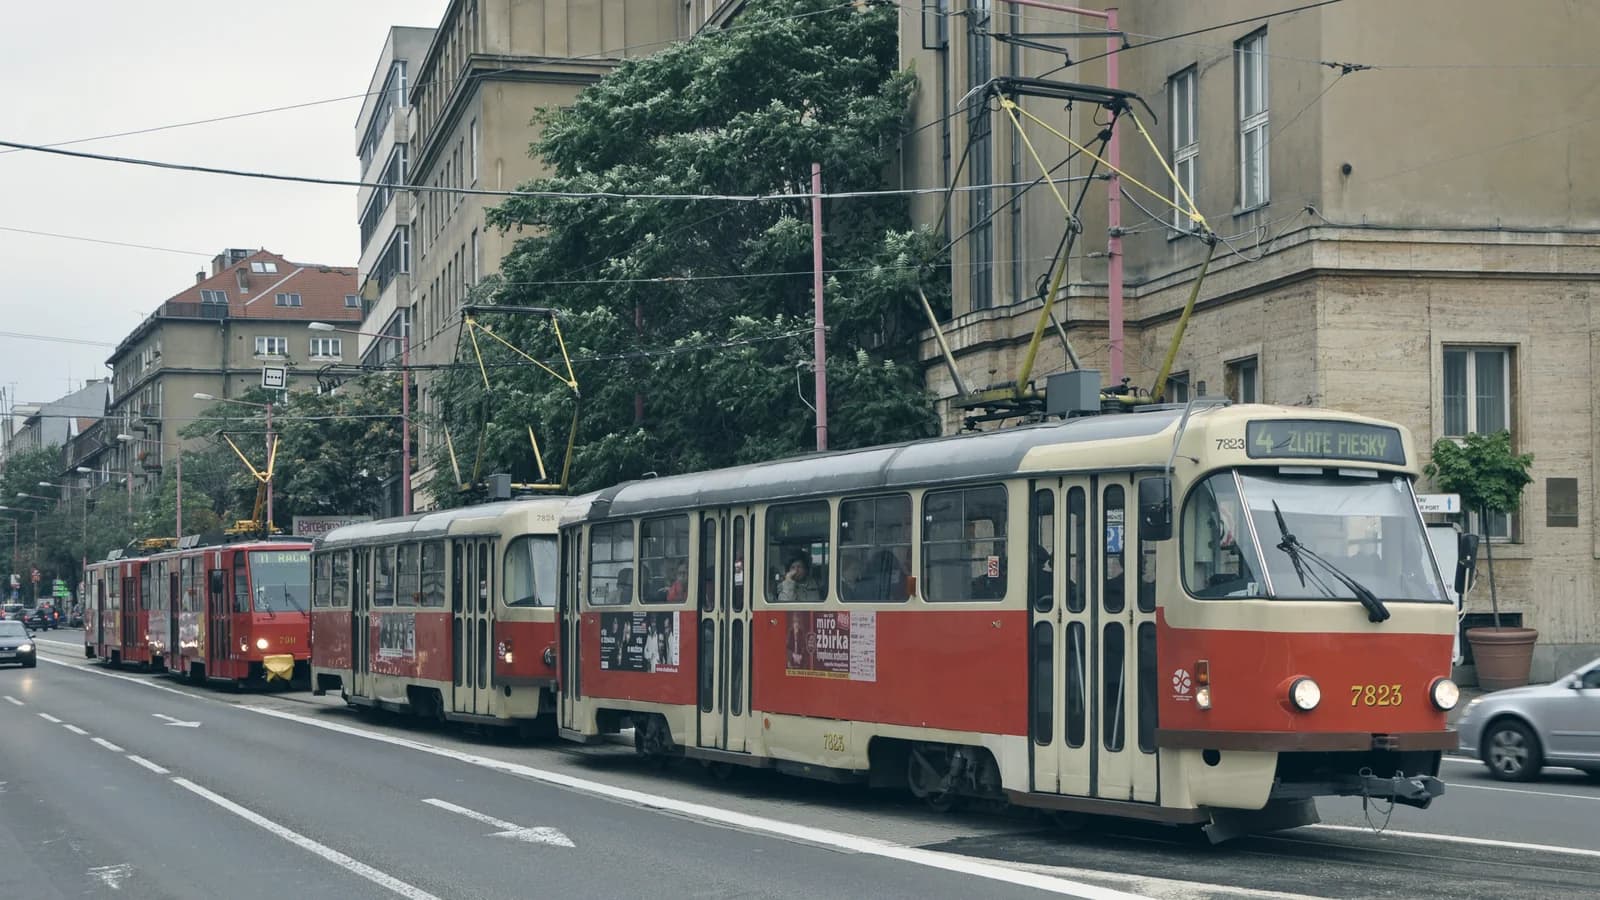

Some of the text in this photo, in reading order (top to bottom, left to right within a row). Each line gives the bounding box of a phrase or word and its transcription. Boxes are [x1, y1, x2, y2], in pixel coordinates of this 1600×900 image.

[1215, 439, 1245, 451] 7823
[1255, 423, 1274, 454] 4
[1337, 432, 1387, 458] PIESKY
[816, 617, 836, 630] miro
[816, 629, 849, 650] žbirka
[1351, 684, 1403, 707] 7823
[823, 733, 845, 753] 7823
